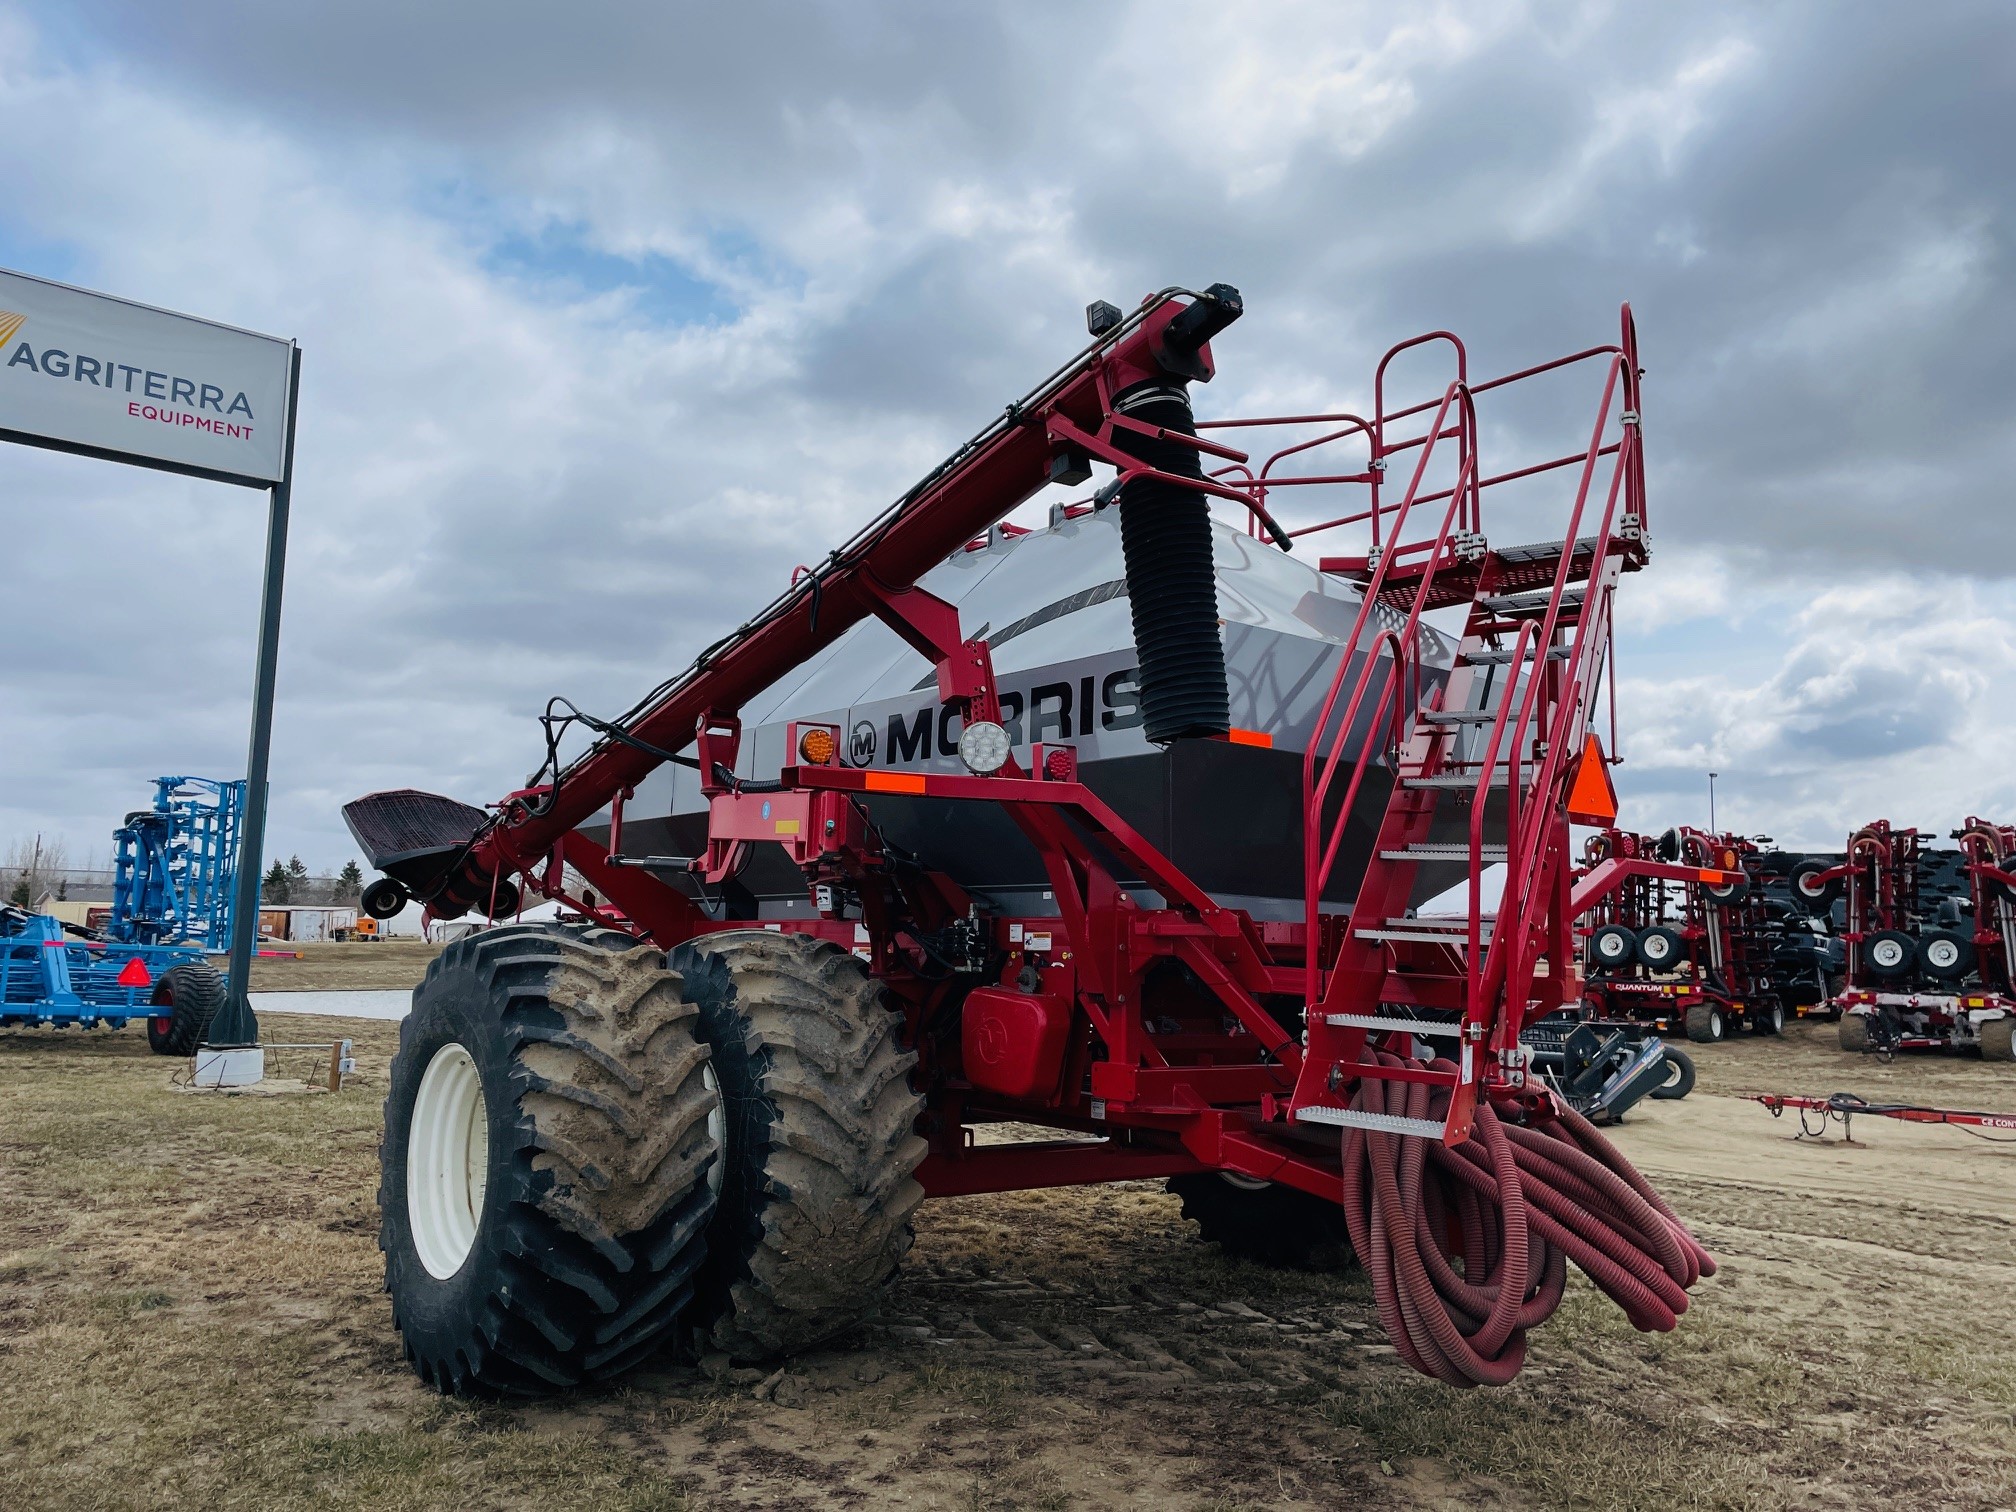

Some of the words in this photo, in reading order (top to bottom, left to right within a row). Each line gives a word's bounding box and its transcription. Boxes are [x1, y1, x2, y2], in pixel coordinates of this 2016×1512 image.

[7, 342, 254, 420] AGRITERRA
[128, 402, 254, 440] EQUIPMENT
[886, 666, 1146, 765] MORRIS
[1615, 983, 1663, 992] QUANTUM
